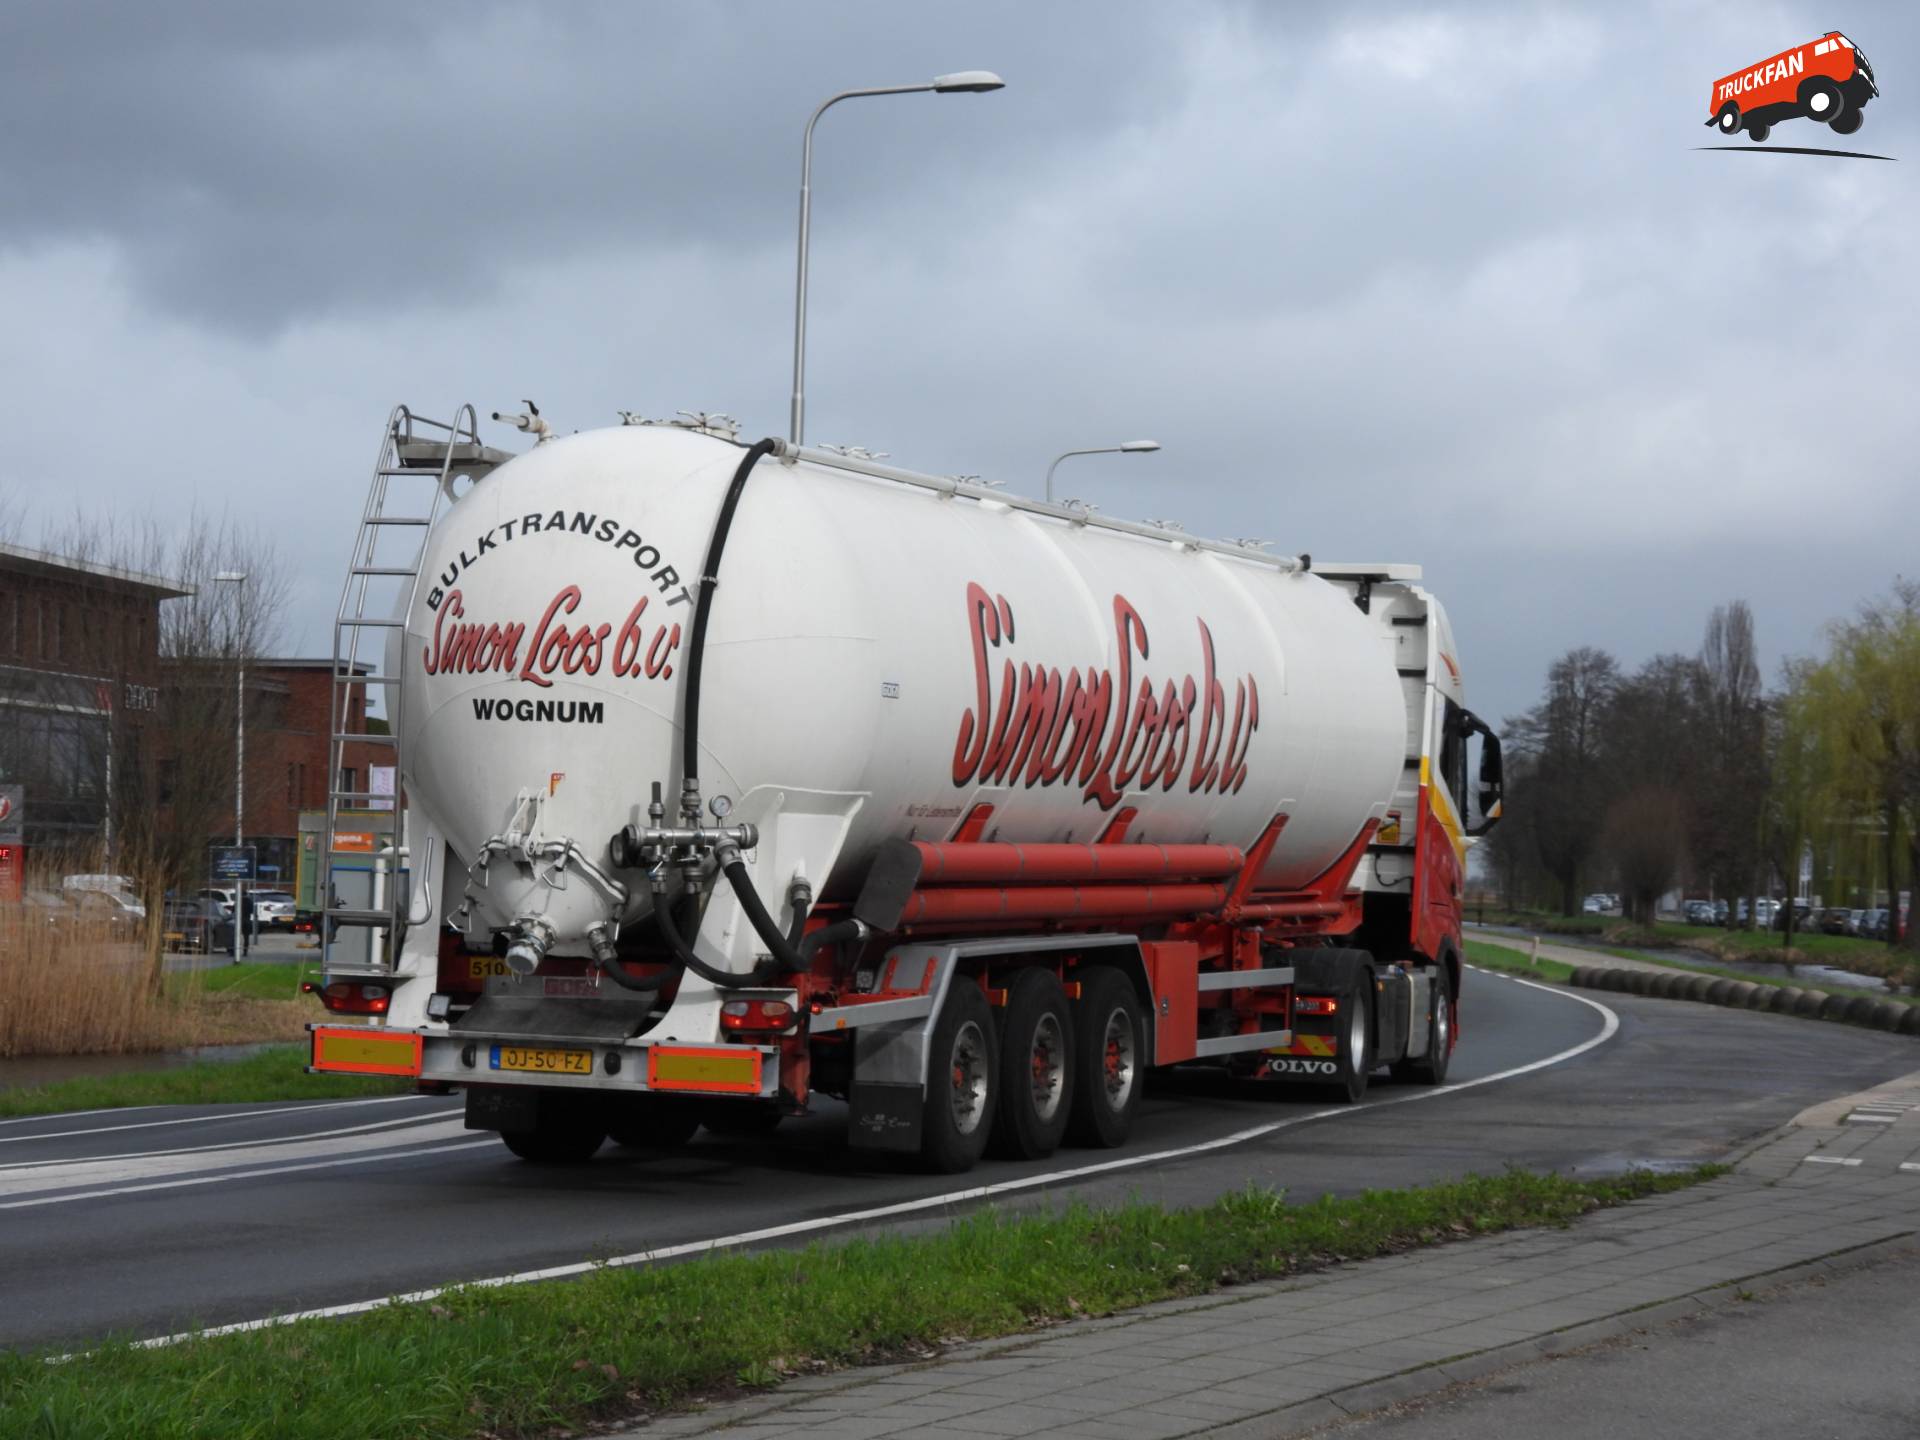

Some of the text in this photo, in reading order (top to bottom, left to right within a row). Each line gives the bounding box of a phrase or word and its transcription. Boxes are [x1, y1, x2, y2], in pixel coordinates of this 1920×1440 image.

[426, 510, 694, 612] BULKTRANSPORT
[424, 588, 525, 676] Simon
[519, 584, 611, 688] Loos
[472, 698, 604, 724] WOGNUM
[952, 581, 1112, 789] Simon
[1083, 594, 1196, 811] Loos
